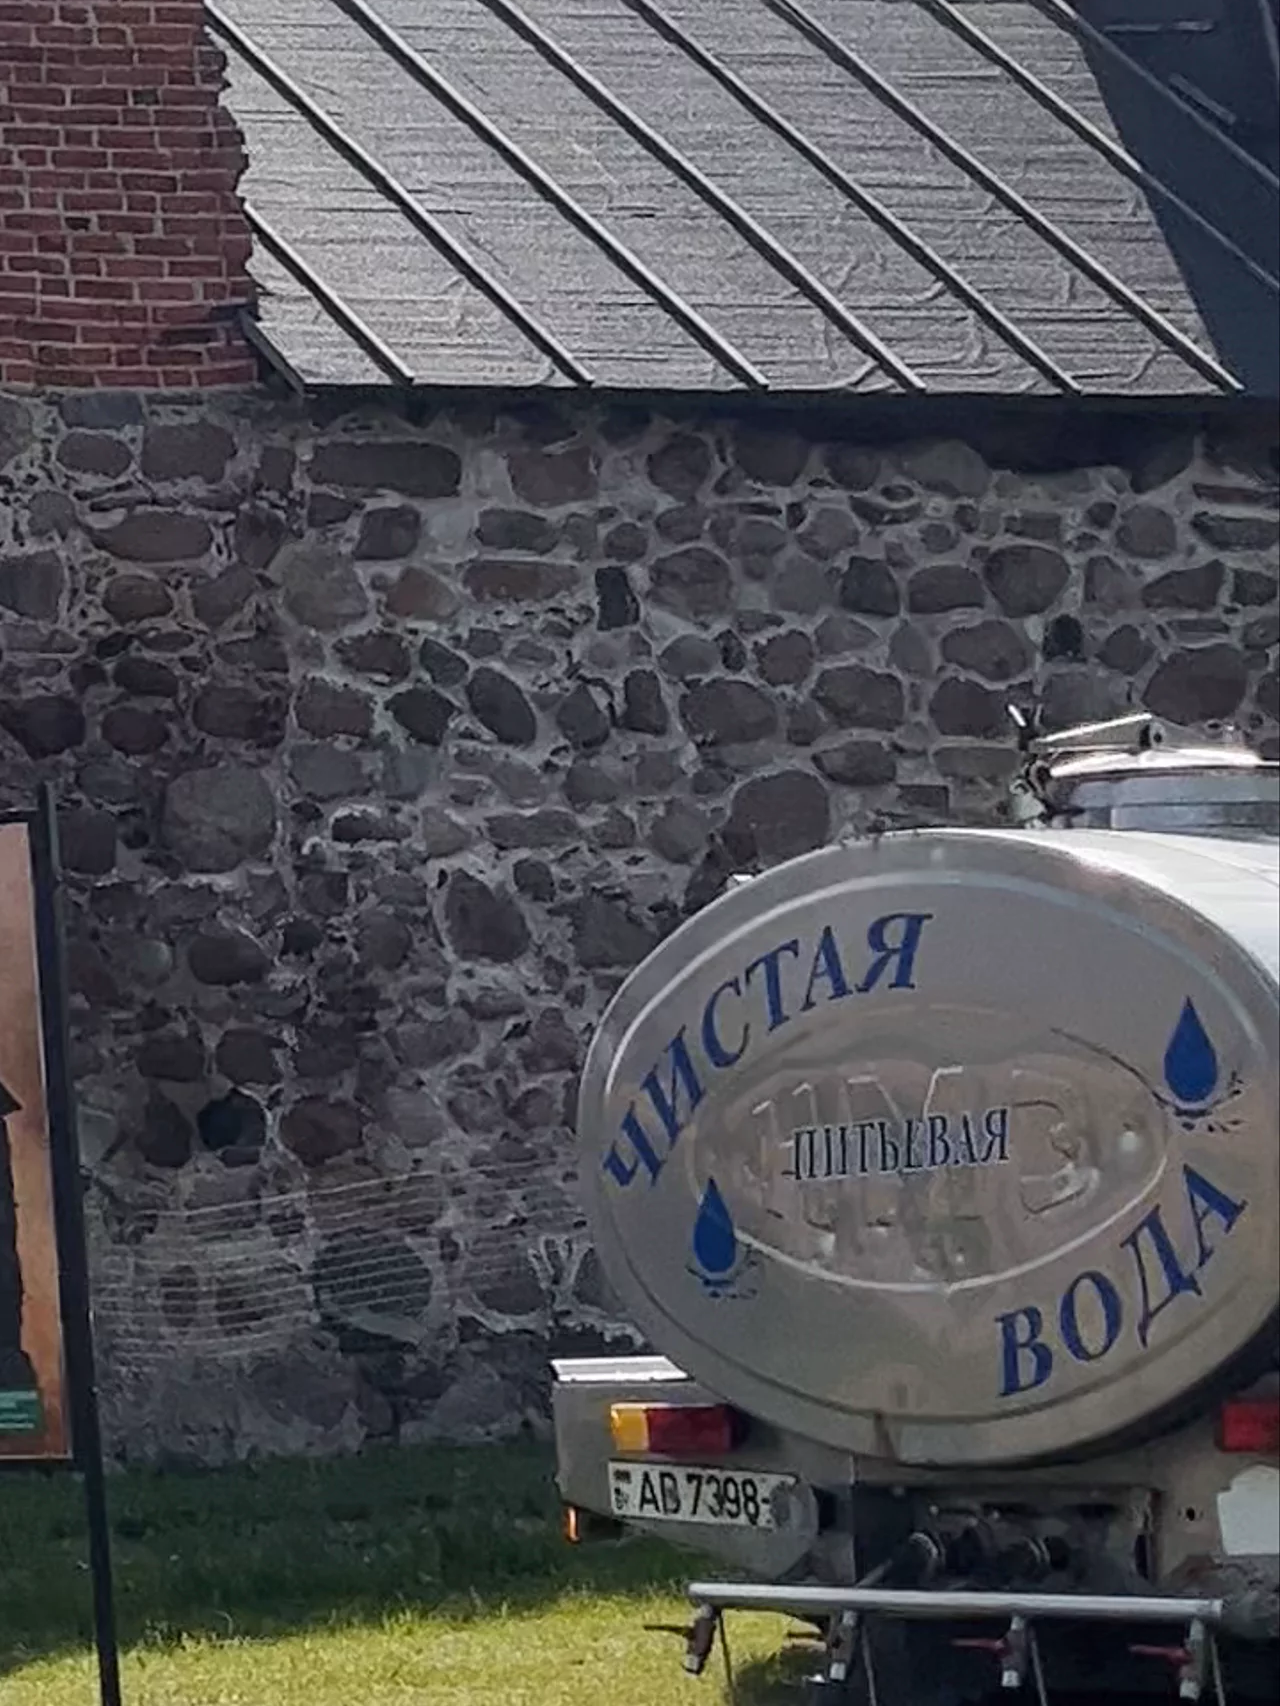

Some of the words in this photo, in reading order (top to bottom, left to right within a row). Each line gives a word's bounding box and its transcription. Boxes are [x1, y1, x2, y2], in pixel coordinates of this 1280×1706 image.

[603, 912, 933, 1187] ЧИСТАЯ
[792, 1107, 1010, 1181] ПИТЬЕВАЯ
[994, 1163, 1249, 1399] ВОДА
[685, 1472, 772, 1526] 7398-
